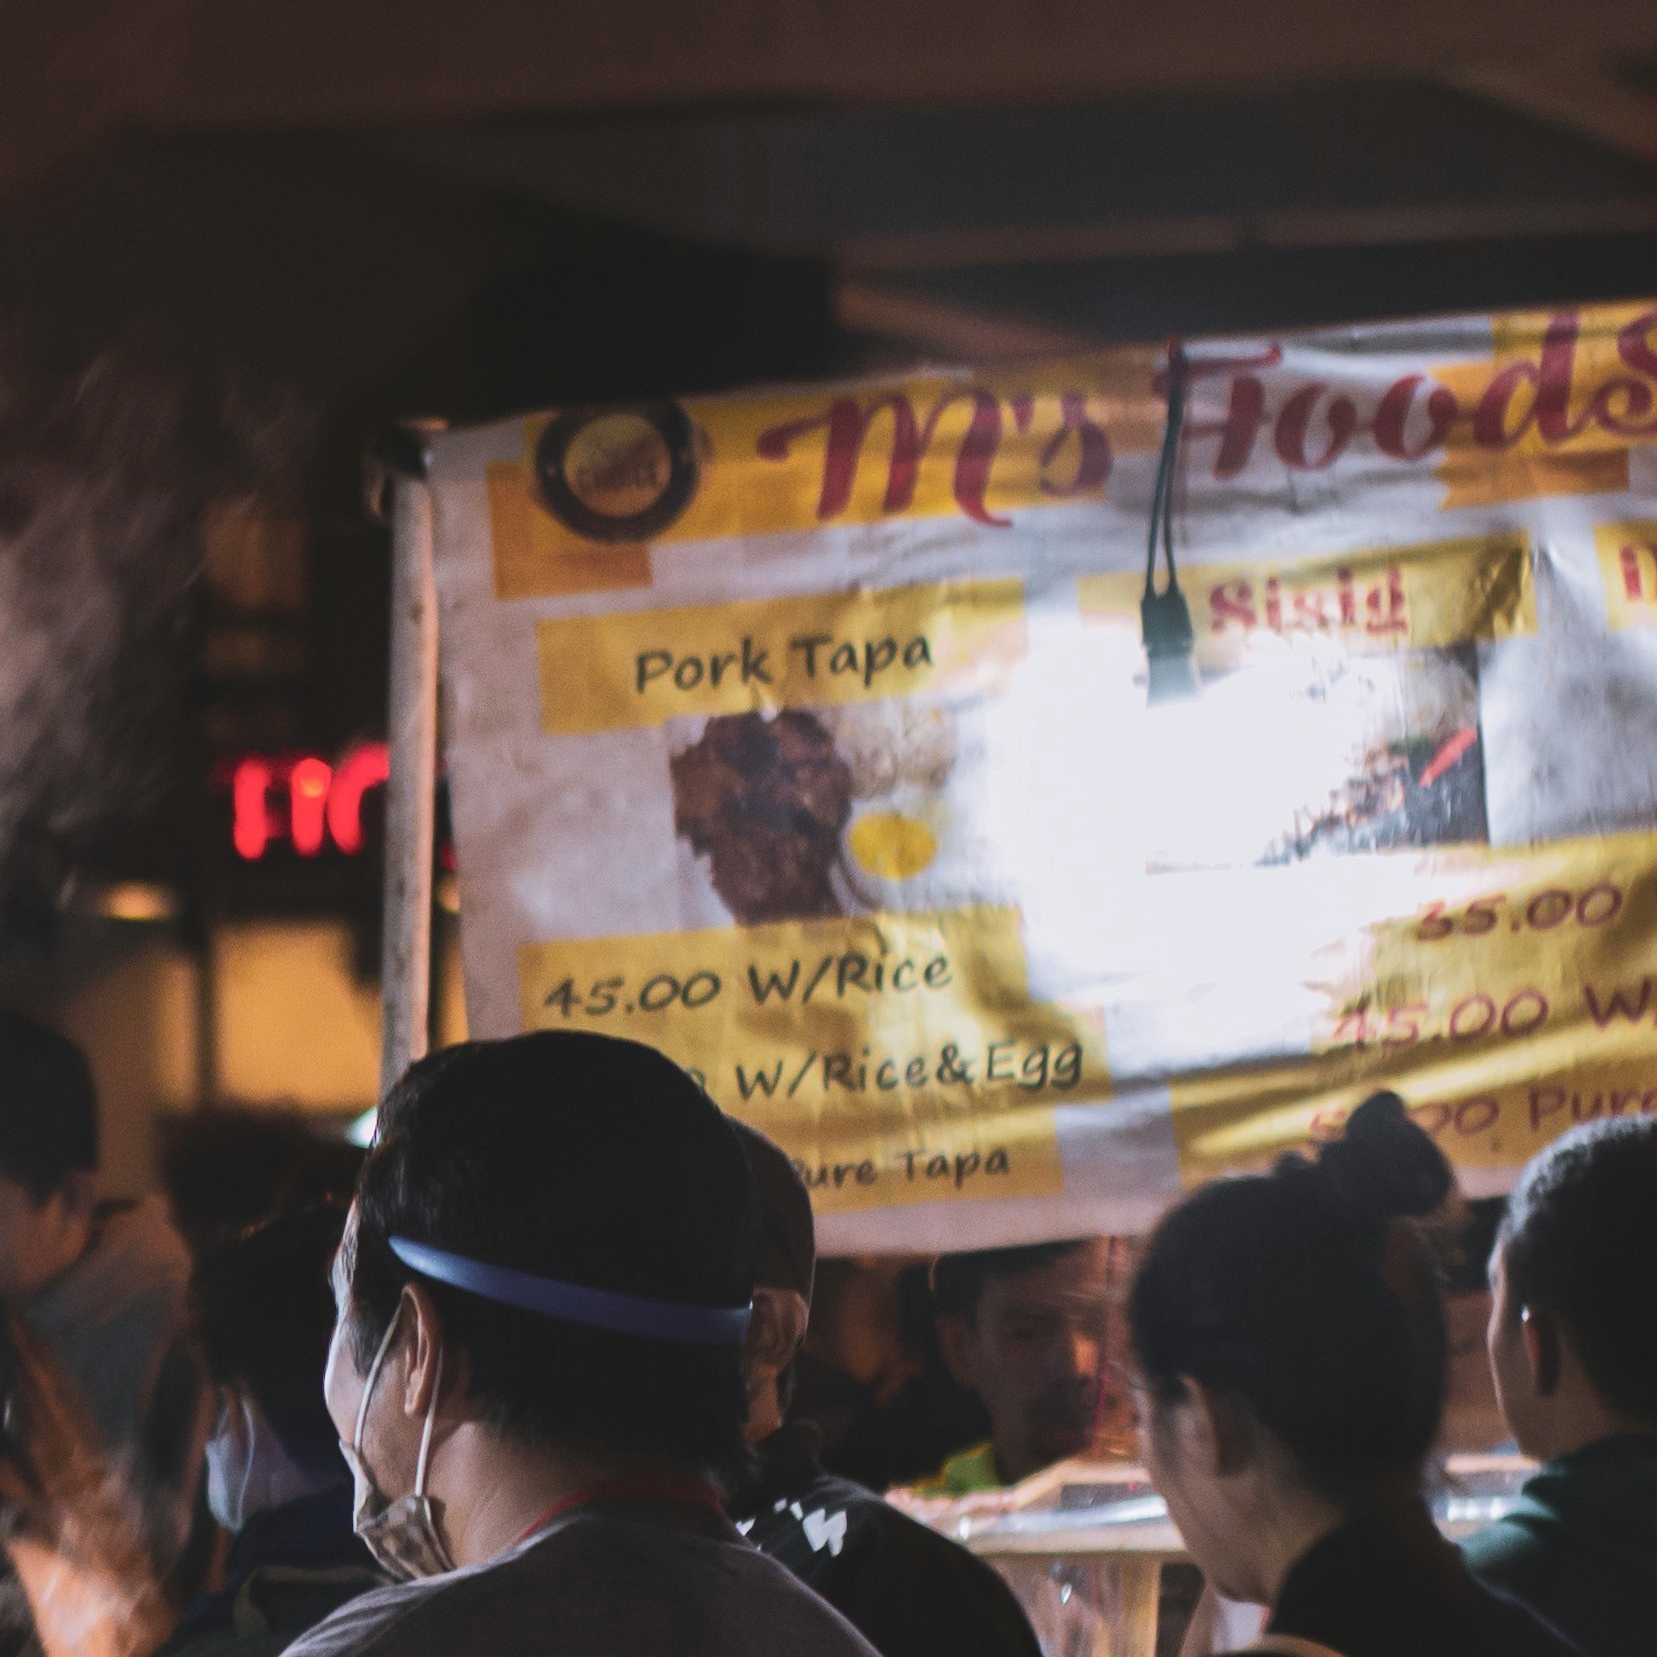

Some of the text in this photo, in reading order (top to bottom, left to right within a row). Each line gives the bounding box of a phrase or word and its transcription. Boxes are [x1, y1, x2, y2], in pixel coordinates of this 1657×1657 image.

[635, 632, 935, 694] Pork Tapa
[544, 949, 954, 1019] 45.00 W/Rice
[736, 1040, 1084, 1100] W/Rice&Egg
[900, 1147, 1009, 1189] Tapa
